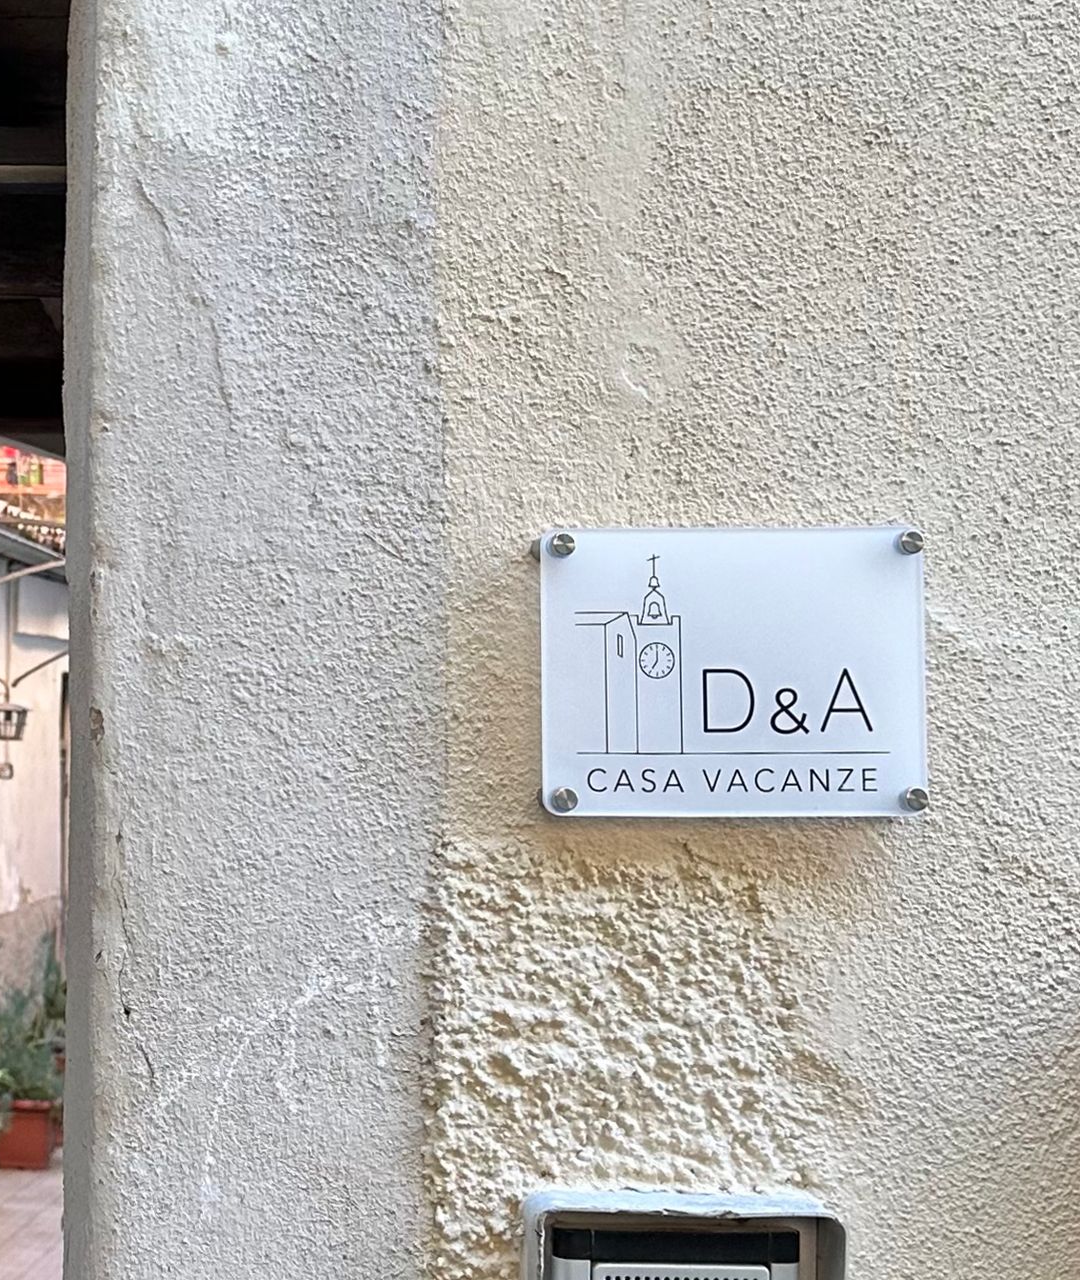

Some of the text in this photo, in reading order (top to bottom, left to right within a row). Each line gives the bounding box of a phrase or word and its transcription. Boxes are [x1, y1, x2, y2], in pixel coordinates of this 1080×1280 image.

[702, 668, 874, 734] D&A
[587, 768, 879, 793] CASA VACANZE
